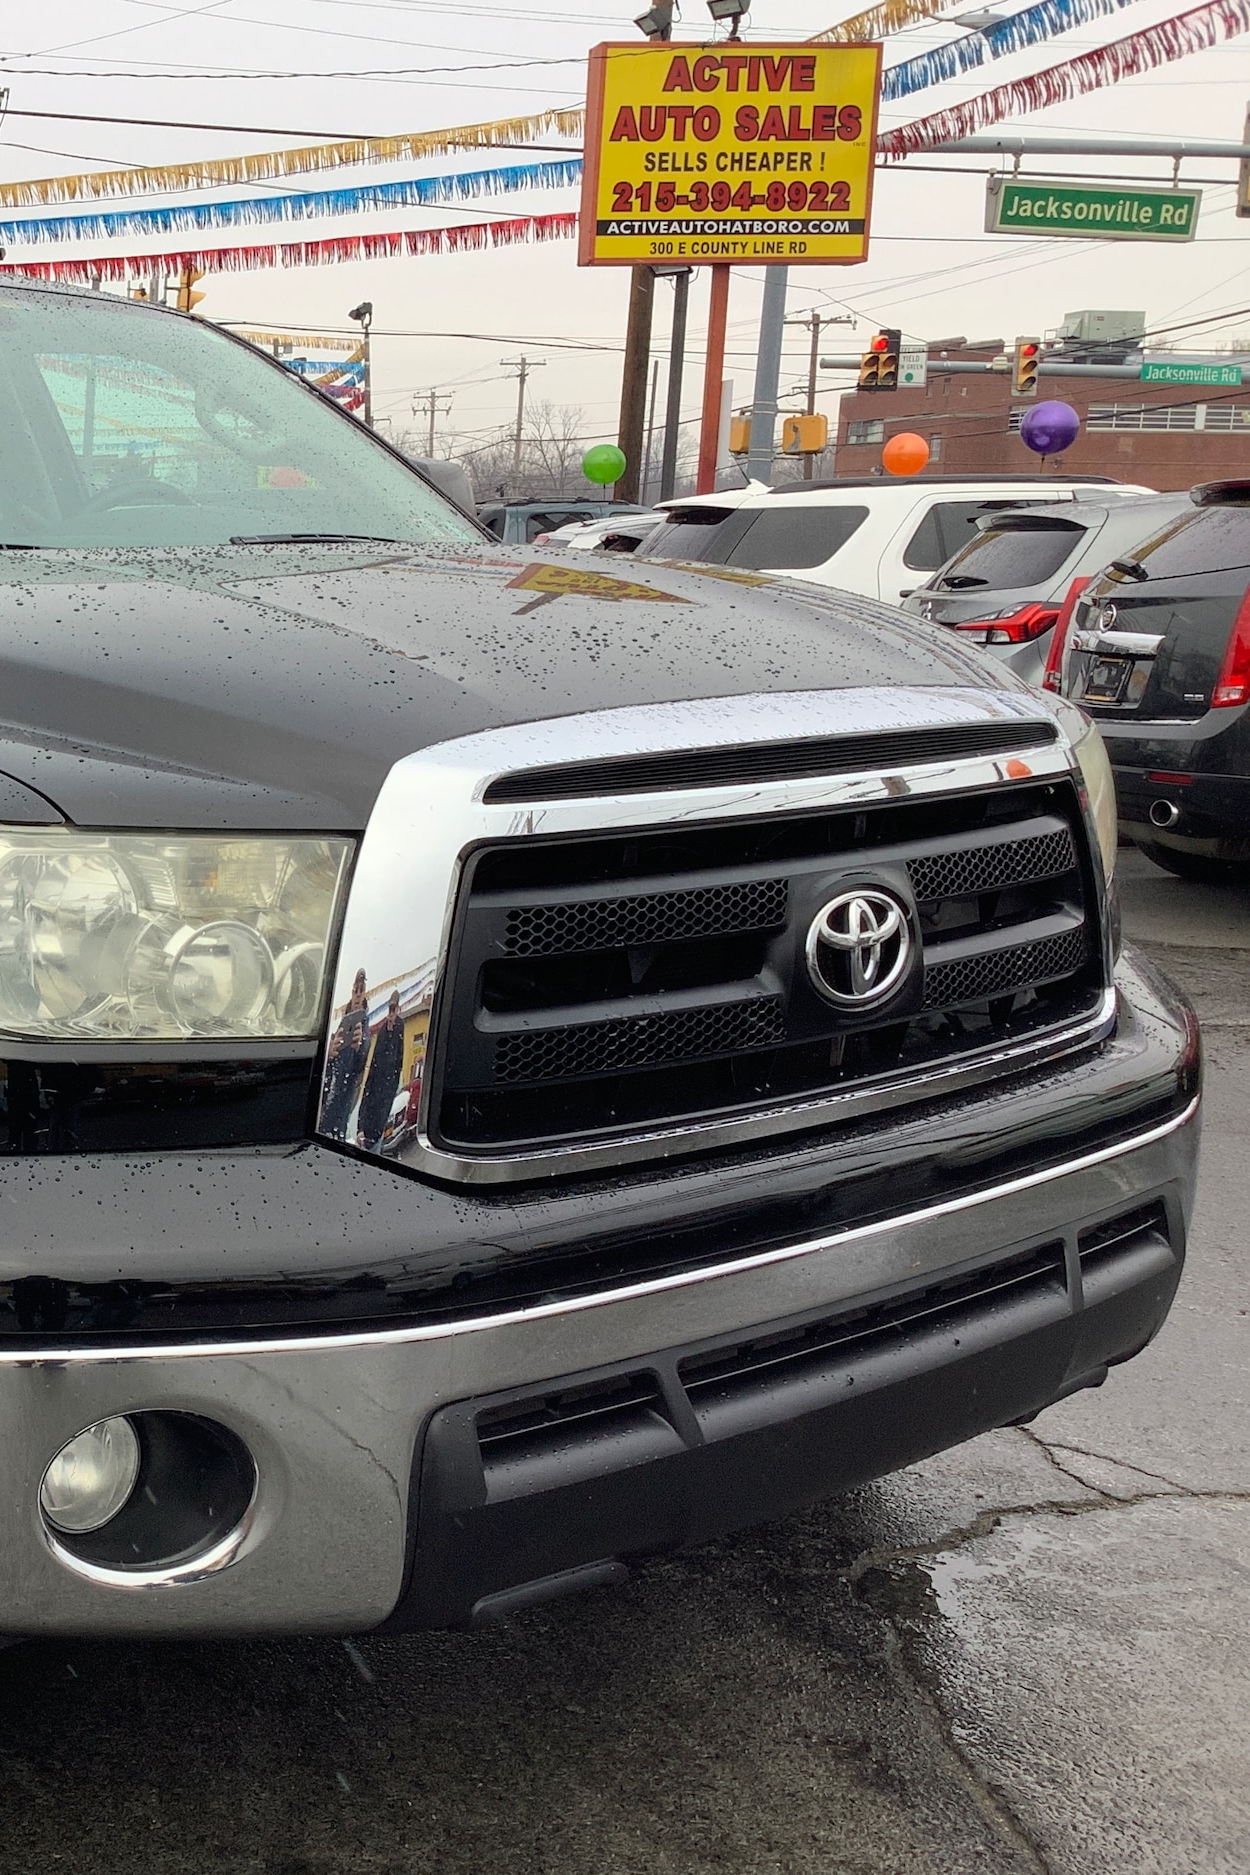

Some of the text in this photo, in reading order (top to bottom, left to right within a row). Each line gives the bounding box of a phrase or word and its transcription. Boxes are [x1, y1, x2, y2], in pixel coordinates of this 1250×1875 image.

[662, 55, 816, 92] ACTIVE
[609, 105, 862, 142] AUTO SALES
[644, 152, 708, 172] SELLS
[715, 151, 813, 172] CHEAPER
[611, 181, 851, 212] 215-394-8922
[1006, 195, 1189, 226] Jacksonville Rd
[606, 221, 850, 234] ACTIVEAUTOHATBORO.COM
[649, 241, 807, 255] 300 E COUNTY LINE RD
[1145, 366, 1237, 383] Jacksonville Rd
